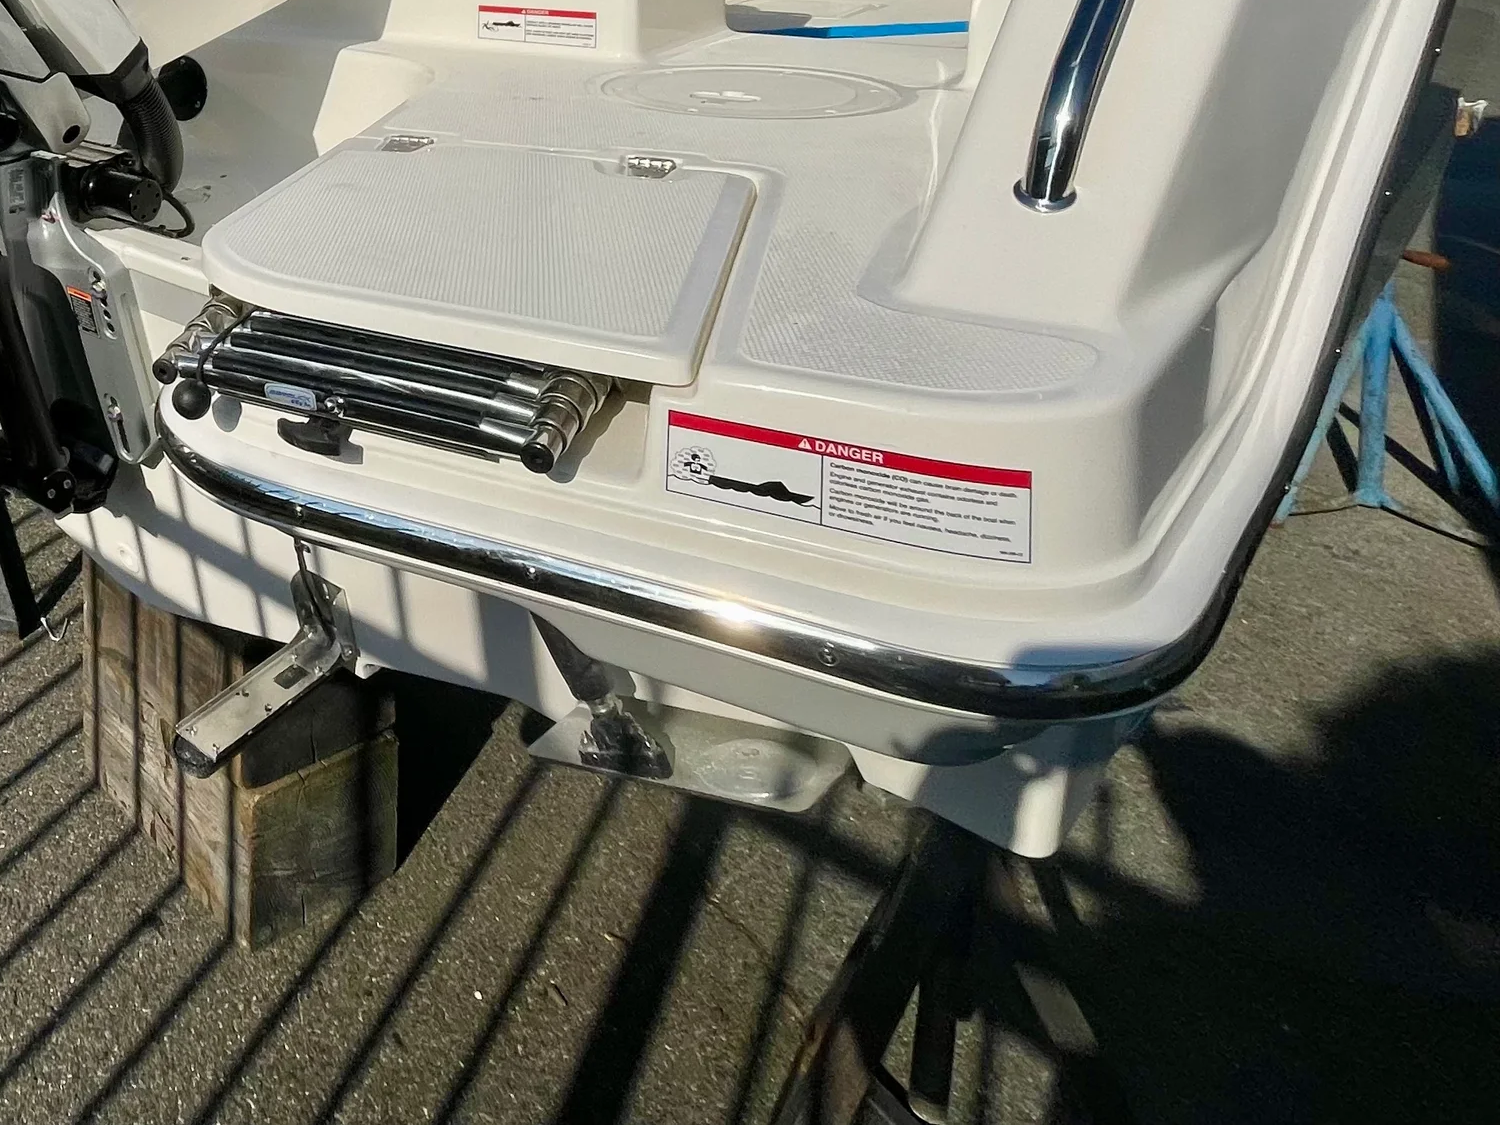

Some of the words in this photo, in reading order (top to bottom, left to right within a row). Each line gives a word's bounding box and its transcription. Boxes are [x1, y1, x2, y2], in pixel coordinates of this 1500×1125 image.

[815, 440, 884, 464] DANGER
[829, 462, 854, 471] Carbon
[856, 468, 890, 478] monoxide
[891, 474, 908, 482] (CO)
[830, 471, 852, 481] Engine
[829, 488, 852, 496] Carbon
[854, 493, 885, 503] monoxide
[883, 490, 914, 500] monoxide
